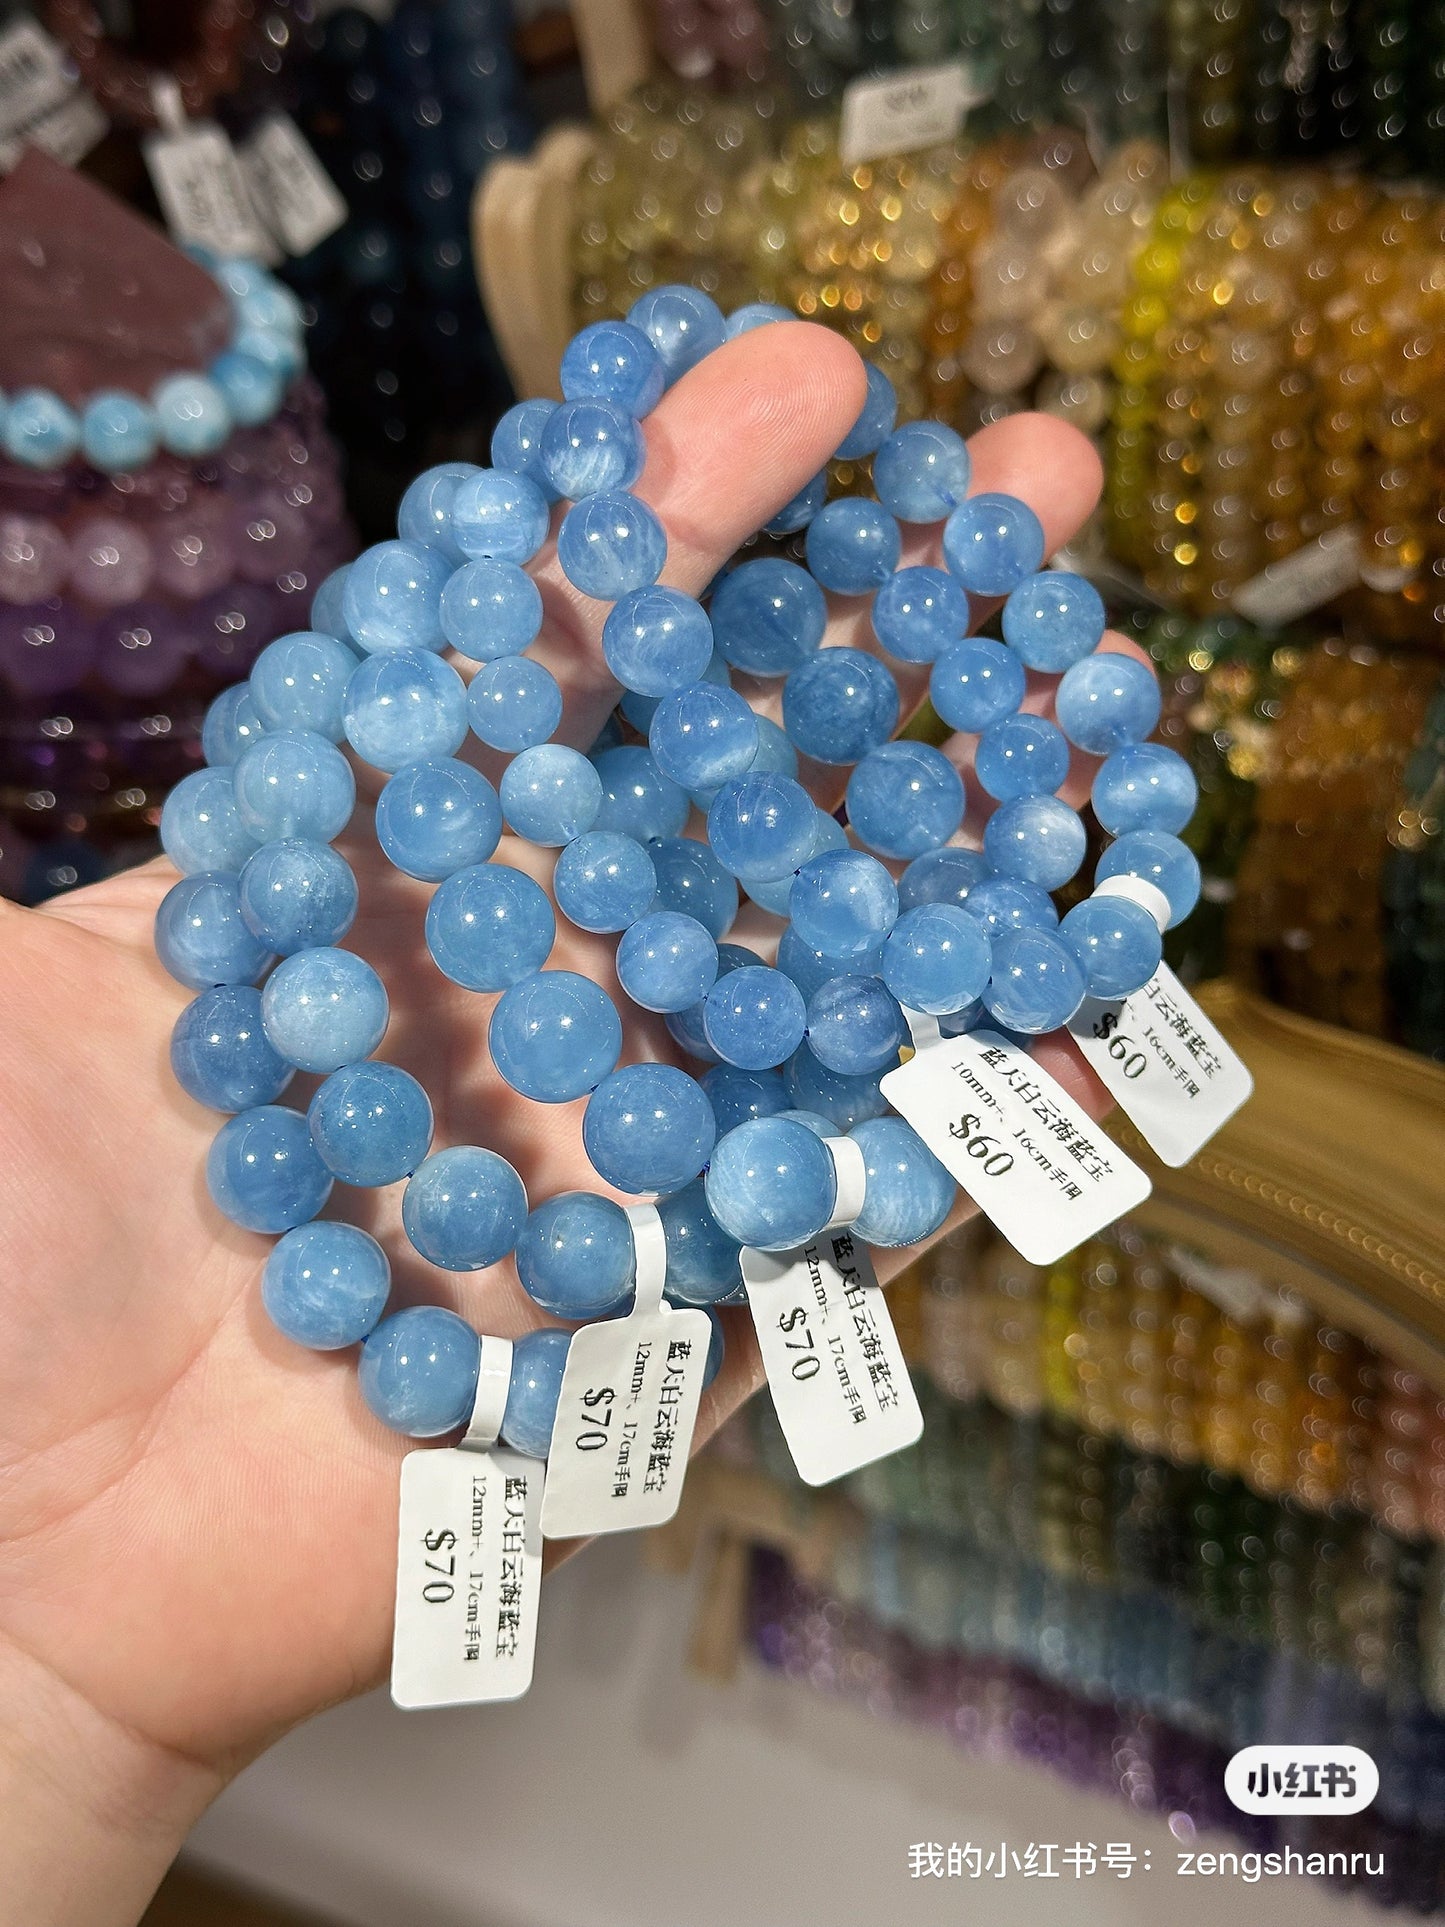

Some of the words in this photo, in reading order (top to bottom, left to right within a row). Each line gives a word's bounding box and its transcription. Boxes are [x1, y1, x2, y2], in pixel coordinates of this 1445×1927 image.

[1093, 1012, 1147, 1079] $60
[949, 1113, 1015, 1177] $60
[776, 1306, 820, 1380] $70
[576, 1387, 619, 1451] $70
[420, 1528, 460, 1604] $70
